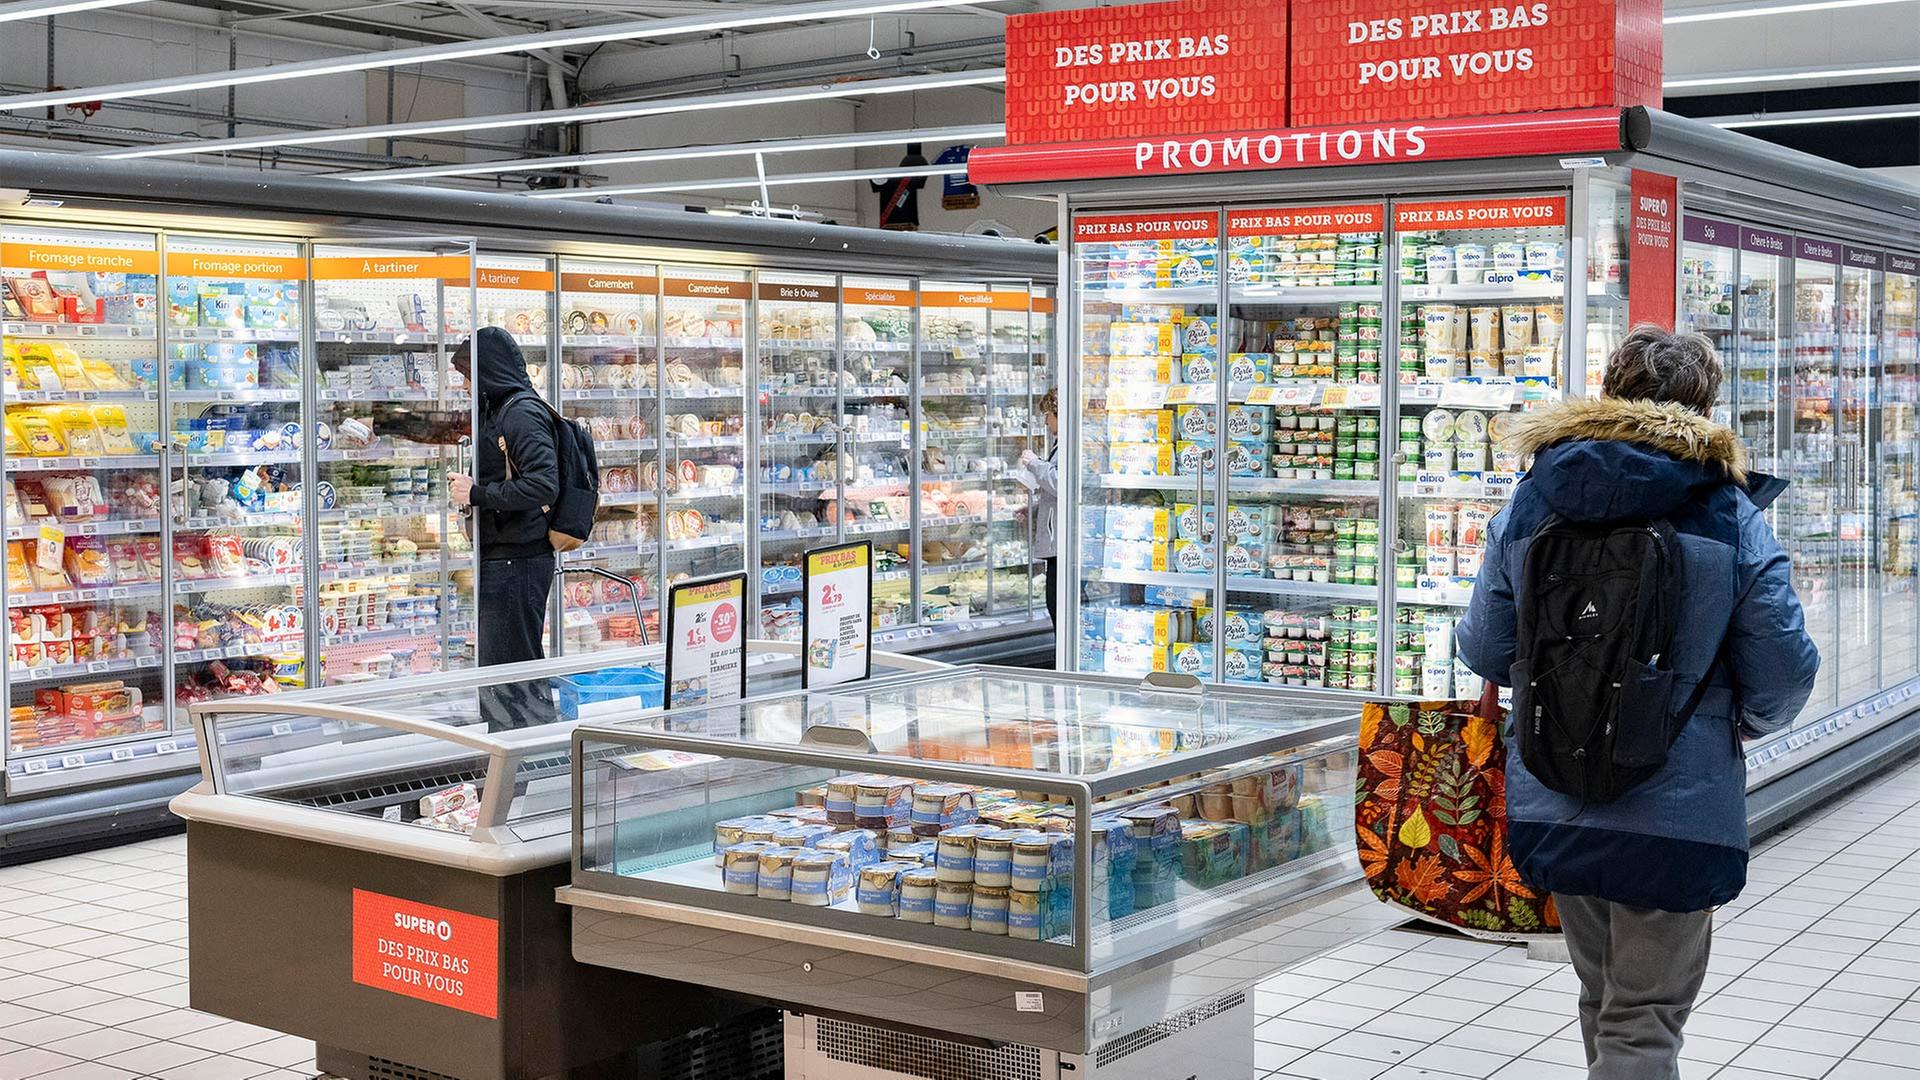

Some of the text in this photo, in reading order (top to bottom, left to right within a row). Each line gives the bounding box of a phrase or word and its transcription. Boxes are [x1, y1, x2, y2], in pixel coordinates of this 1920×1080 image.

[1349, 3, 1549, 44] DES PRIX BAS
[1055, 34, 1230, 68] DES PRIX BAS
[1358, 48, 1534, 85] POUR VOUS
[1064, 76, 1217, 106] POUR VOUS
[1135, 126, 1427, 170] PROMOTIONS
[1640, 196, 1660, 214] SUPER
[1399, 205, 1554, 223] PRIX BAS POUR VOUS
[1231, 213, 1373, 229] PRIX BAS POUR VOUS
[1636, 217, 1671, 233] DES PRIX BAS
[1078, 220, 1209, 235] PRIX BAS POUR VOUS
[1704, 225, 1715, 241] Soja
[1638, 233, 1669, 248] POUR VOUS
[29, 250, 133, 267] Fromage tranche
[1429, 255, 1447, 263] alpro
[1462, 252, 1480, 261] alpro
[1497, 252, 1515, 260] alpro
[1529, 250, 1547, 259] alpro
[193, 258, 283, 275] Fromage portion
[362, 260, 418, 273] À tartiner
[480, 271, 520, 285] À tartiner
[1488, 272, 1514, 284] alpro
[176, 282, 189, 291] Kiri
[258, 285, 271, 294] Kiri
[588, 278, 634, 290] Camembert
[688, 283, 729, 295] Camembert
[780, 288, 819, 298] Brie & Ovale
[864, 291, 896, 302] Spécialités
[215, 299, 230, 310] Kiri
[958, 294, 993, 305] Persillés
[262, 308, 275, 317] Kiri
[1510, 313, 1529, 323] alpro
[1427, 314, 1445, 323] alpro
[1188, 329, 1207, 340] Perle
[1429, 357, 1447, 366] alpro
[1190, 367, 1210, 377] Perle
[1232, 367, 1253, 377] Perle
[1185, 417, 1204, 428] Perle
[1228, 419, 1248, 429] Perle
[1228, 520, 1247, 530] Perle
[820, 551, 857, 565] PRIX BAS
[1181, 553, 1201, 563] Perle
[1227, 556, 1247, 565] Perle
[1225, 625, 1246, 636] Perle
[1181, 656, 1201, 666] Perle
[1226, 662, 1246, 672] Perle
[394, 912, 435, 936] SUPER
[378, 938, 469, 975] DES PRIX BAS
[383, 962, 464, 997] POUR VOUS
